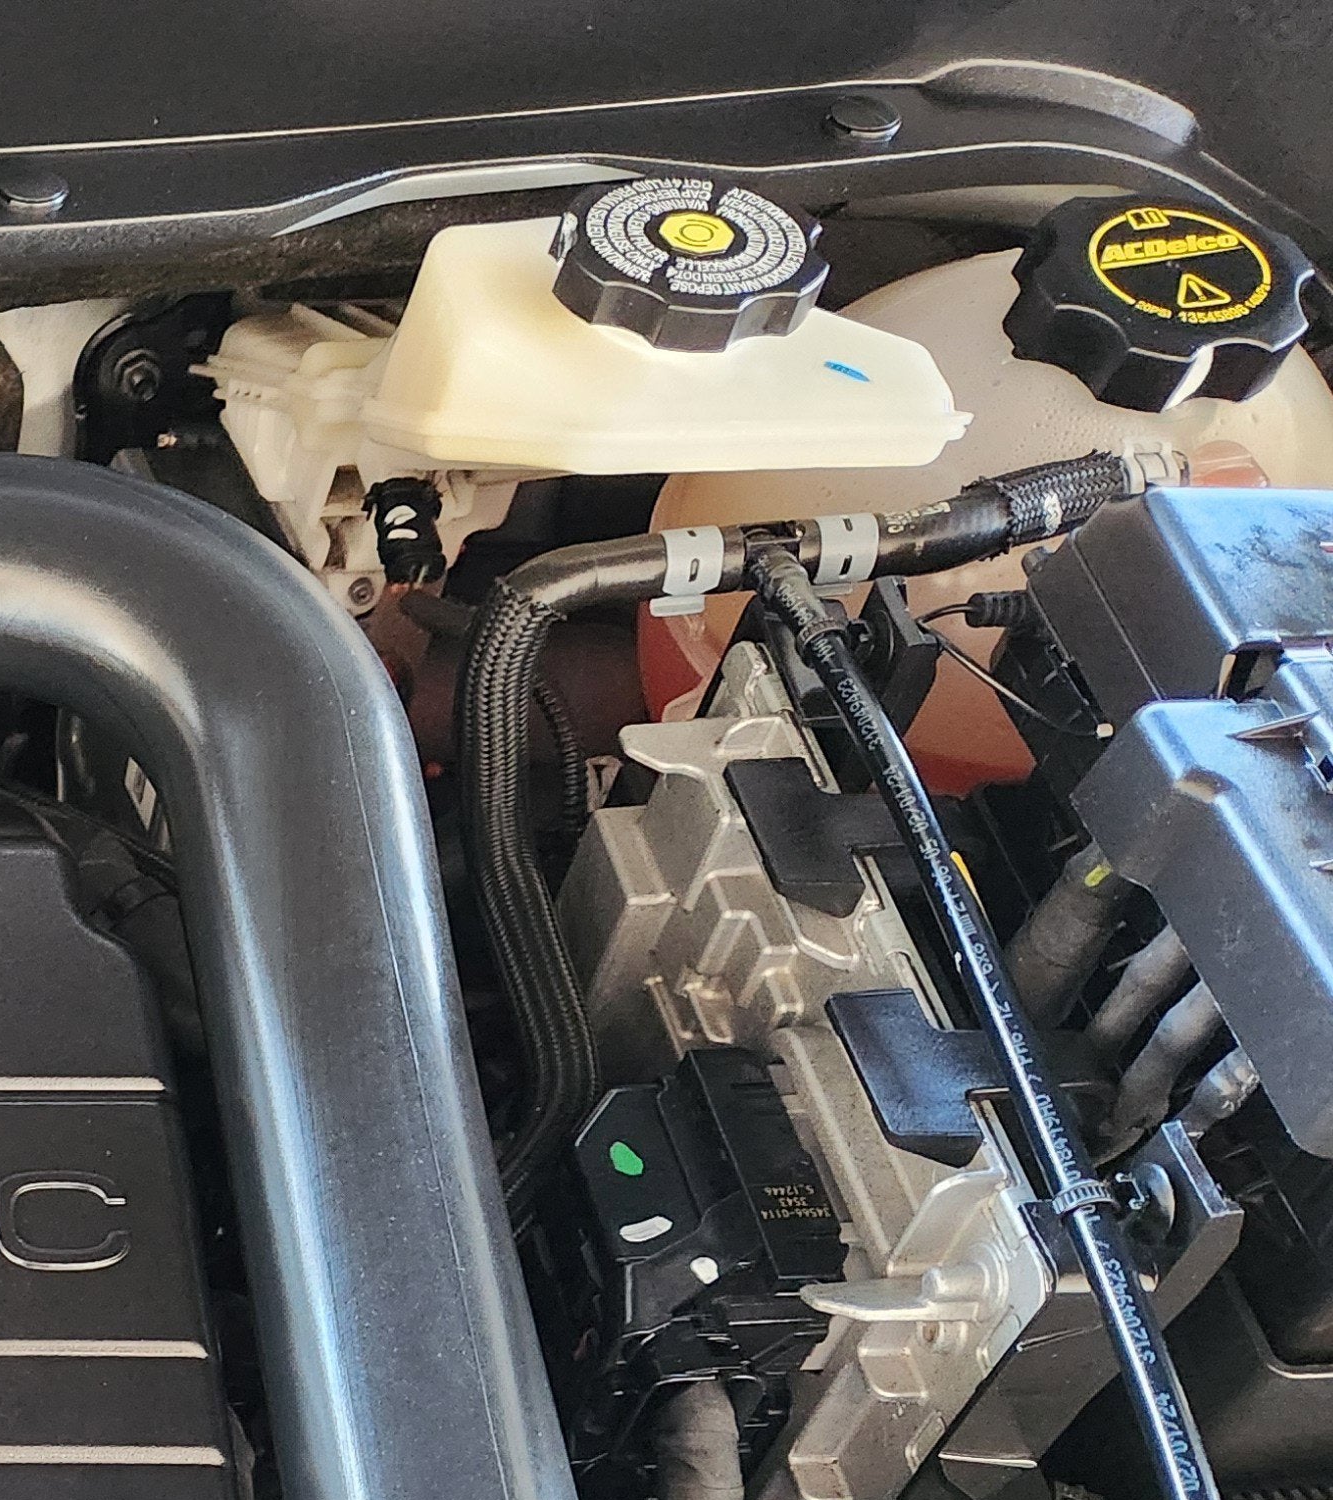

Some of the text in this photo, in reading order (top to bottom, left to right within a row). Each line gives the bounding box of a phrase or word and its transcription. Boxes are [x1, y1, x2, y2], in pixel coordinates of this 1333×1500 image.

[630, 178, 673, 193] FLUID
[679, 189, 712, 200] CAP
[680, 178, 714, 191] DOT
[626, 187, 681, 207] BEFORE
[1100, 234, 1239, 263] ACDelco
[622, 250, 663, 272] ONLY
[673, 269, 701, 282] DOT
[835, 677, 885, 750] 312049423
[1101, 1256, 1158, 1367] 312049423
